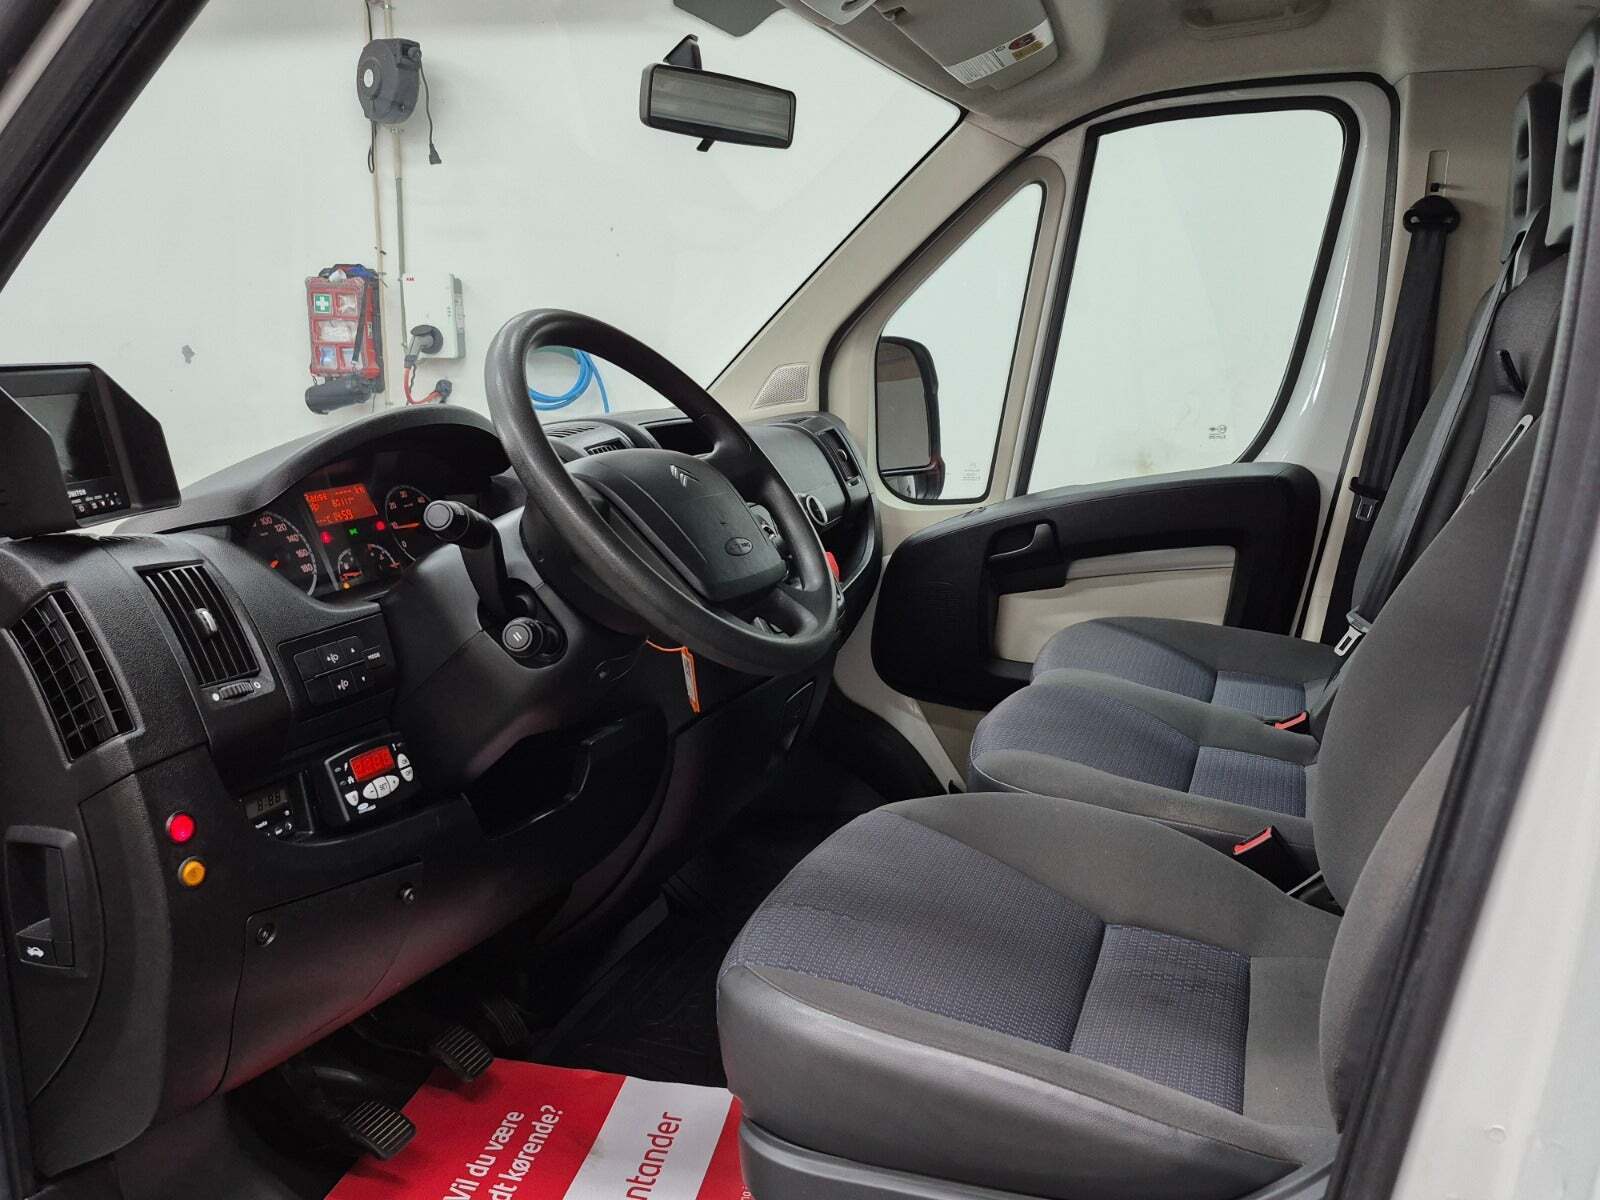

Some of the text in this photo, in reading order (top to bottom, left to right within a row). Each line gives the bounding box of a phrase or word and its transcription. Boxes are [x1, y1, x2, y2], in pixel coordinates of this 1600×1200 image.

[260, 516, 273, 525] 100
[274, 523, 287, 532] 120
[286, 534, 300, 543] 140
[301, 563, 313, 573] 180
[498, 1104, 563, 1181] kørende?
[443, 1111, 524, 1200] Vil du være
[625, 1111, 683, 1200] ntander
